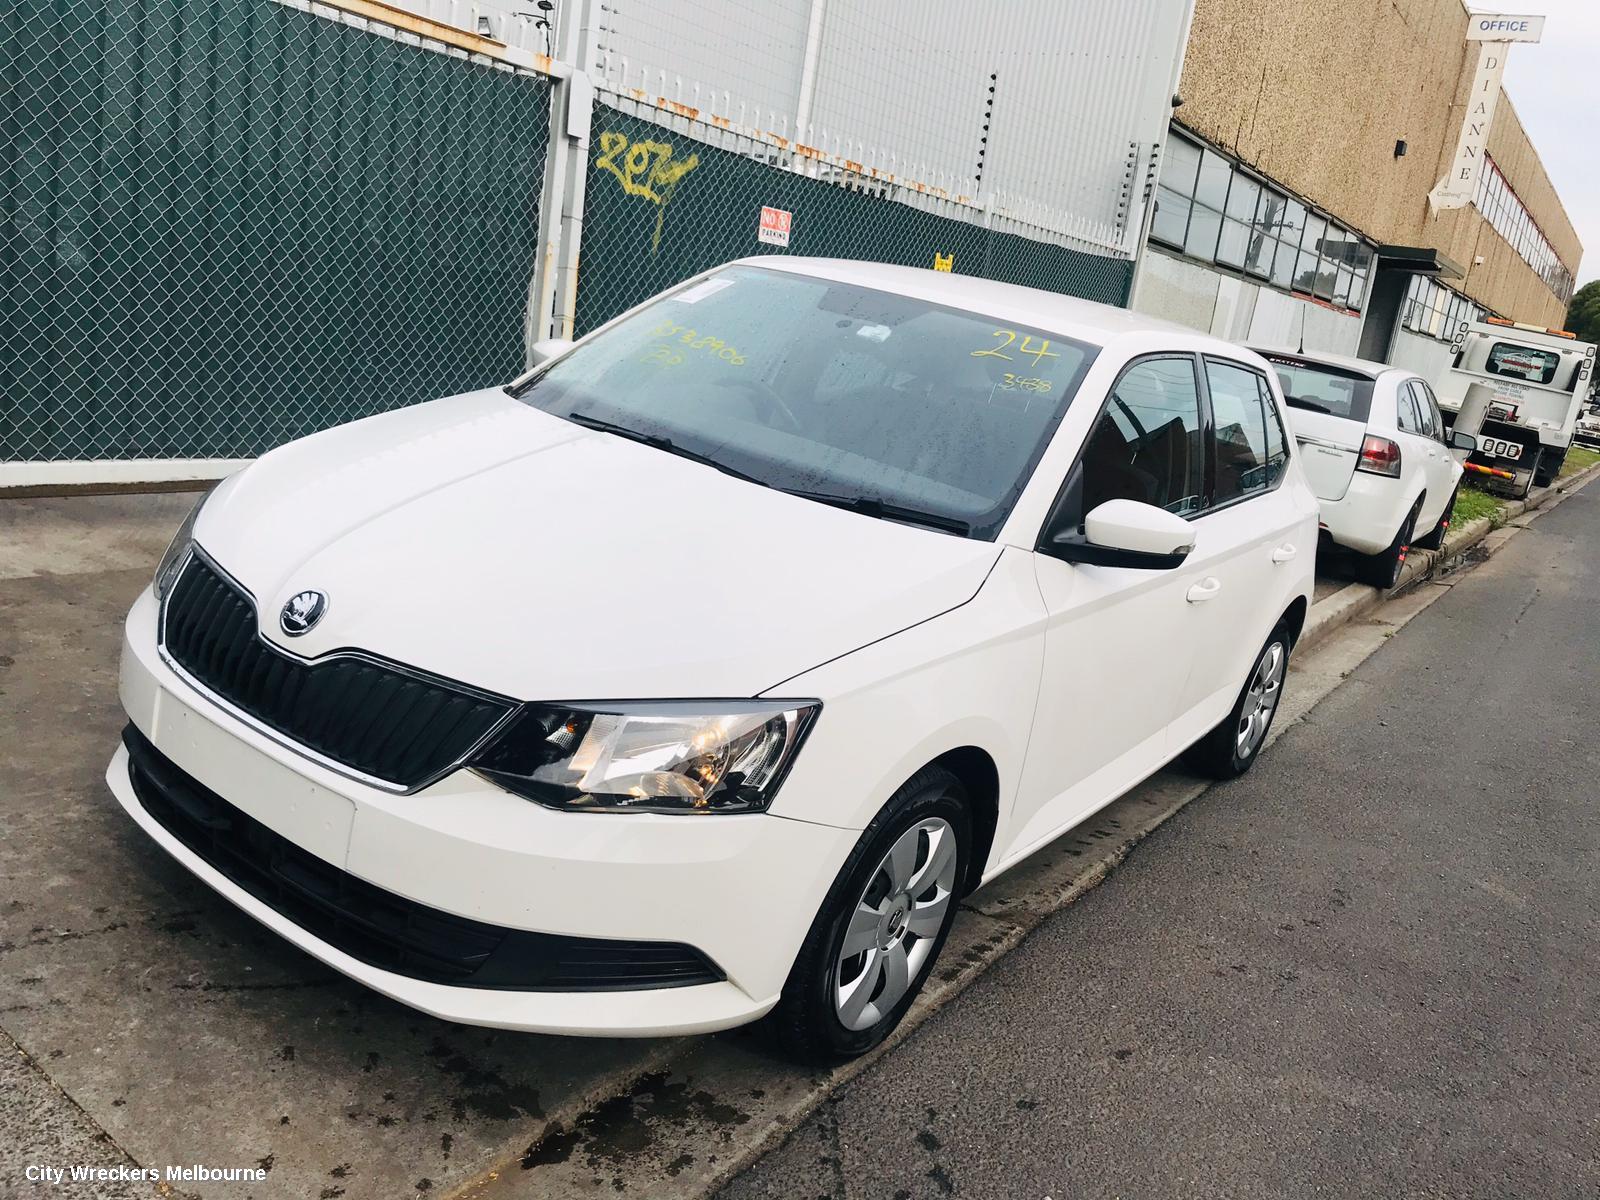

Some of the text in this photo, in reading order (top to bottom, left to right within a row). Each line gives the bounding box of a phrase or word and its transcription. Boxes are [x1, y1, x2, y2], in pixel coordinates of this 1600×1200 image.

[1479, 20, 1529, 32] OFFICE
[1459, 57, 1498, 180] DIANNE
[762, 210, 776, 225] NO
[970, 330, 1061, 368] 24
